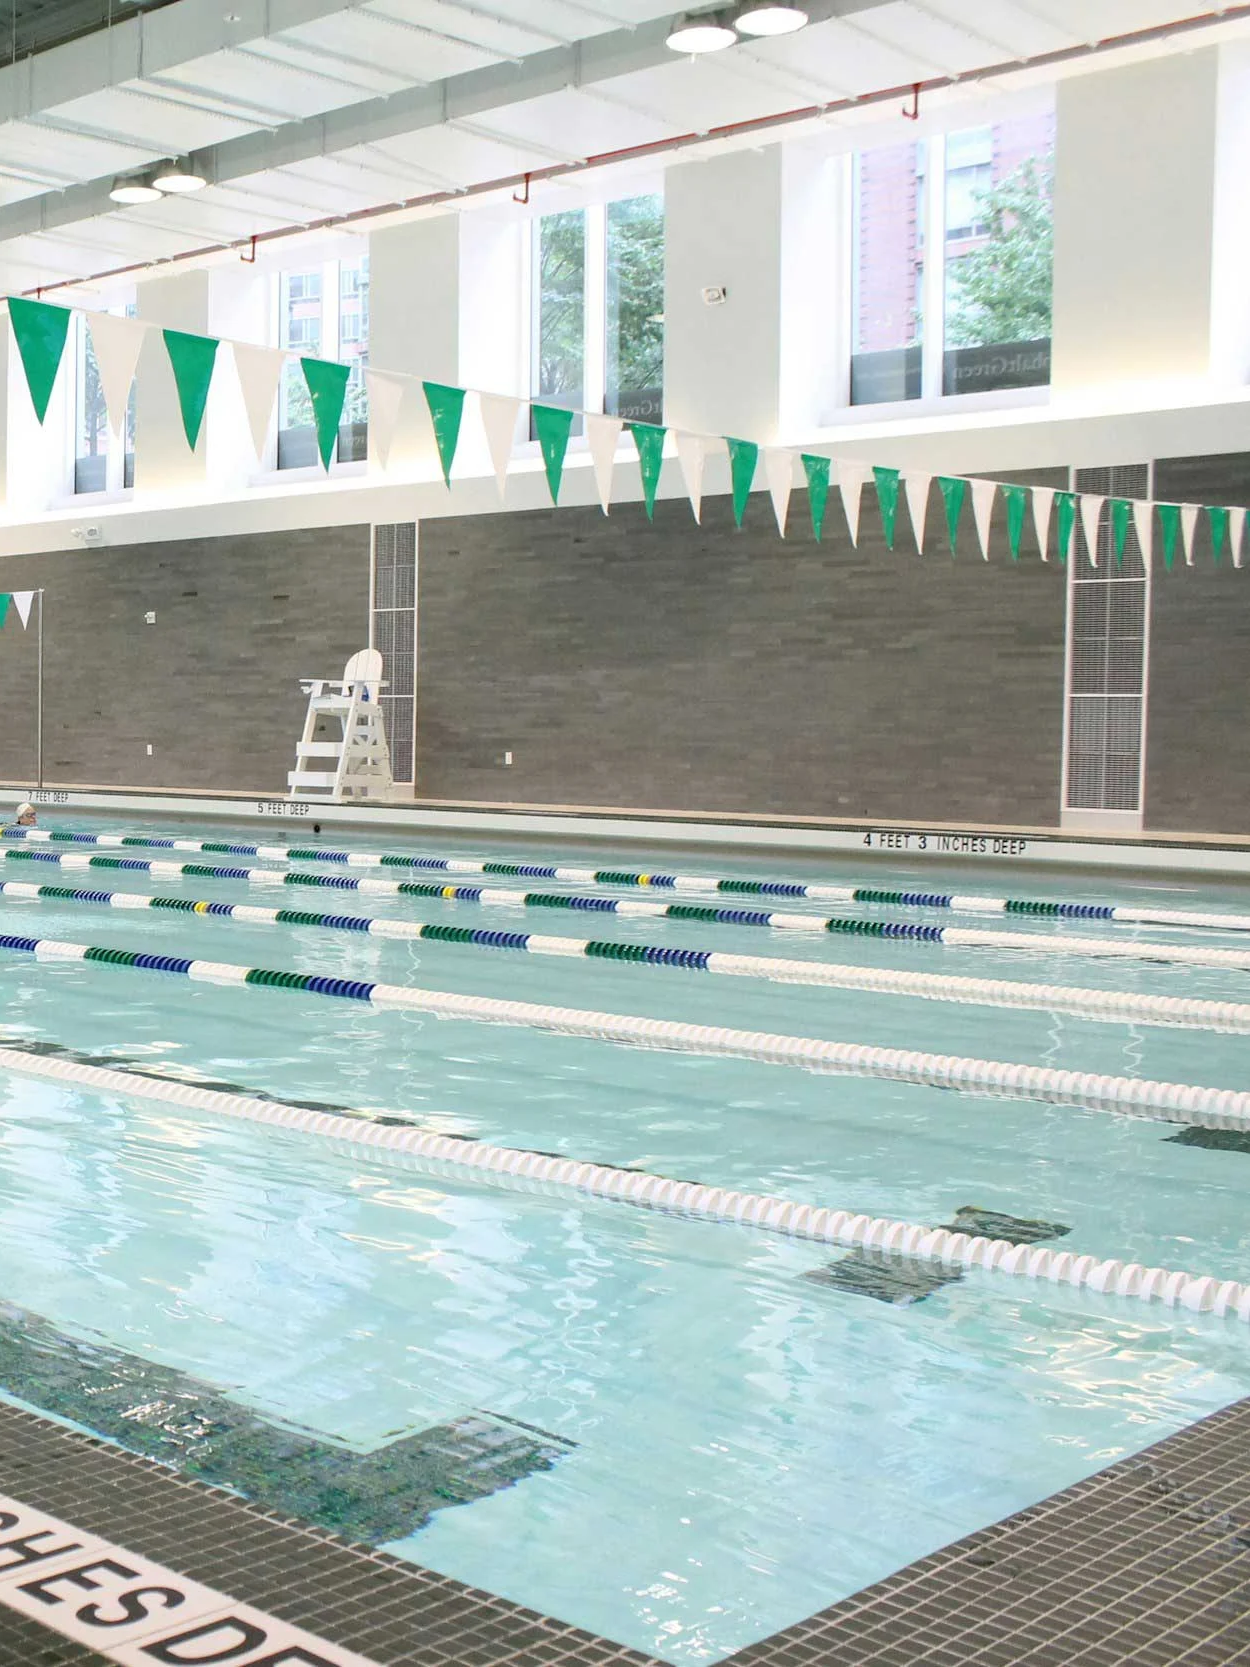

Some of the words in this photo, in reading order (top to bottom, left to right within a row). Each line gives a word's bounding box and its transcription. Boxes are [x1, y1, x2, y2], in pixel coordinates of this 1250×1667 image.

[28, 791, 33, 801] 7
[36, 791, 51, 802] FEET
[53, 792, 69, 803] DEEP
[258, 802, 264, 813] 5
[268, 803, 287, 815] FEET
[290, 804, 310, 816] DEEP
[863, 833, 871, 847] 4
[879, 834, 910, 848] FEET
[918, 836, 927, 850] 3
[937, 837, 987, 852] INCHES
[993, 839, 1026, 855] DEEP
